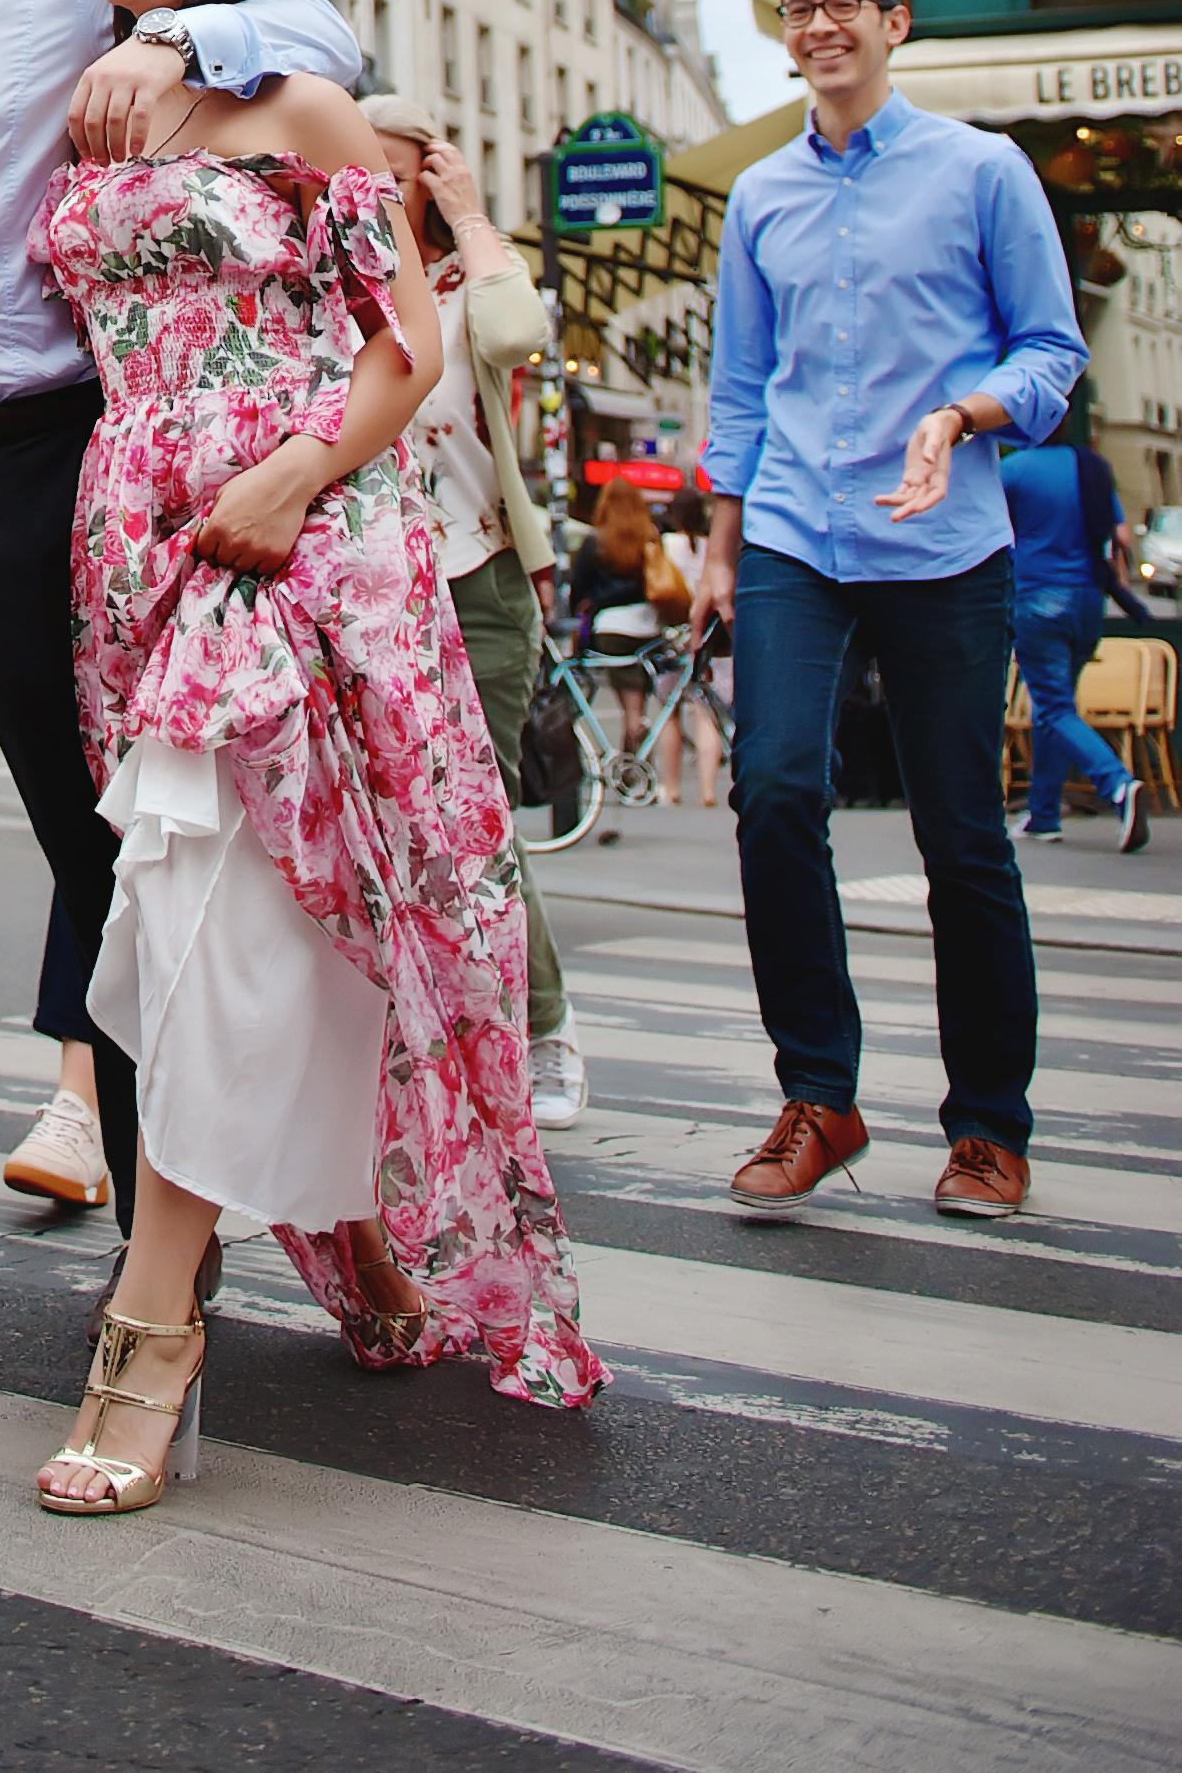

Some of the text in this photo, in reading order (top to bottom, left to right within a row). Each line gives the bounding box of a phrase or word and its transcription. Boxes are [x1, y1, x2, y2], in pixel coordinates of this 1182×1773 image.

[1035, 59, 1182, 104] LE BREB
[566, 161, 647, 183] BOULEVARD
